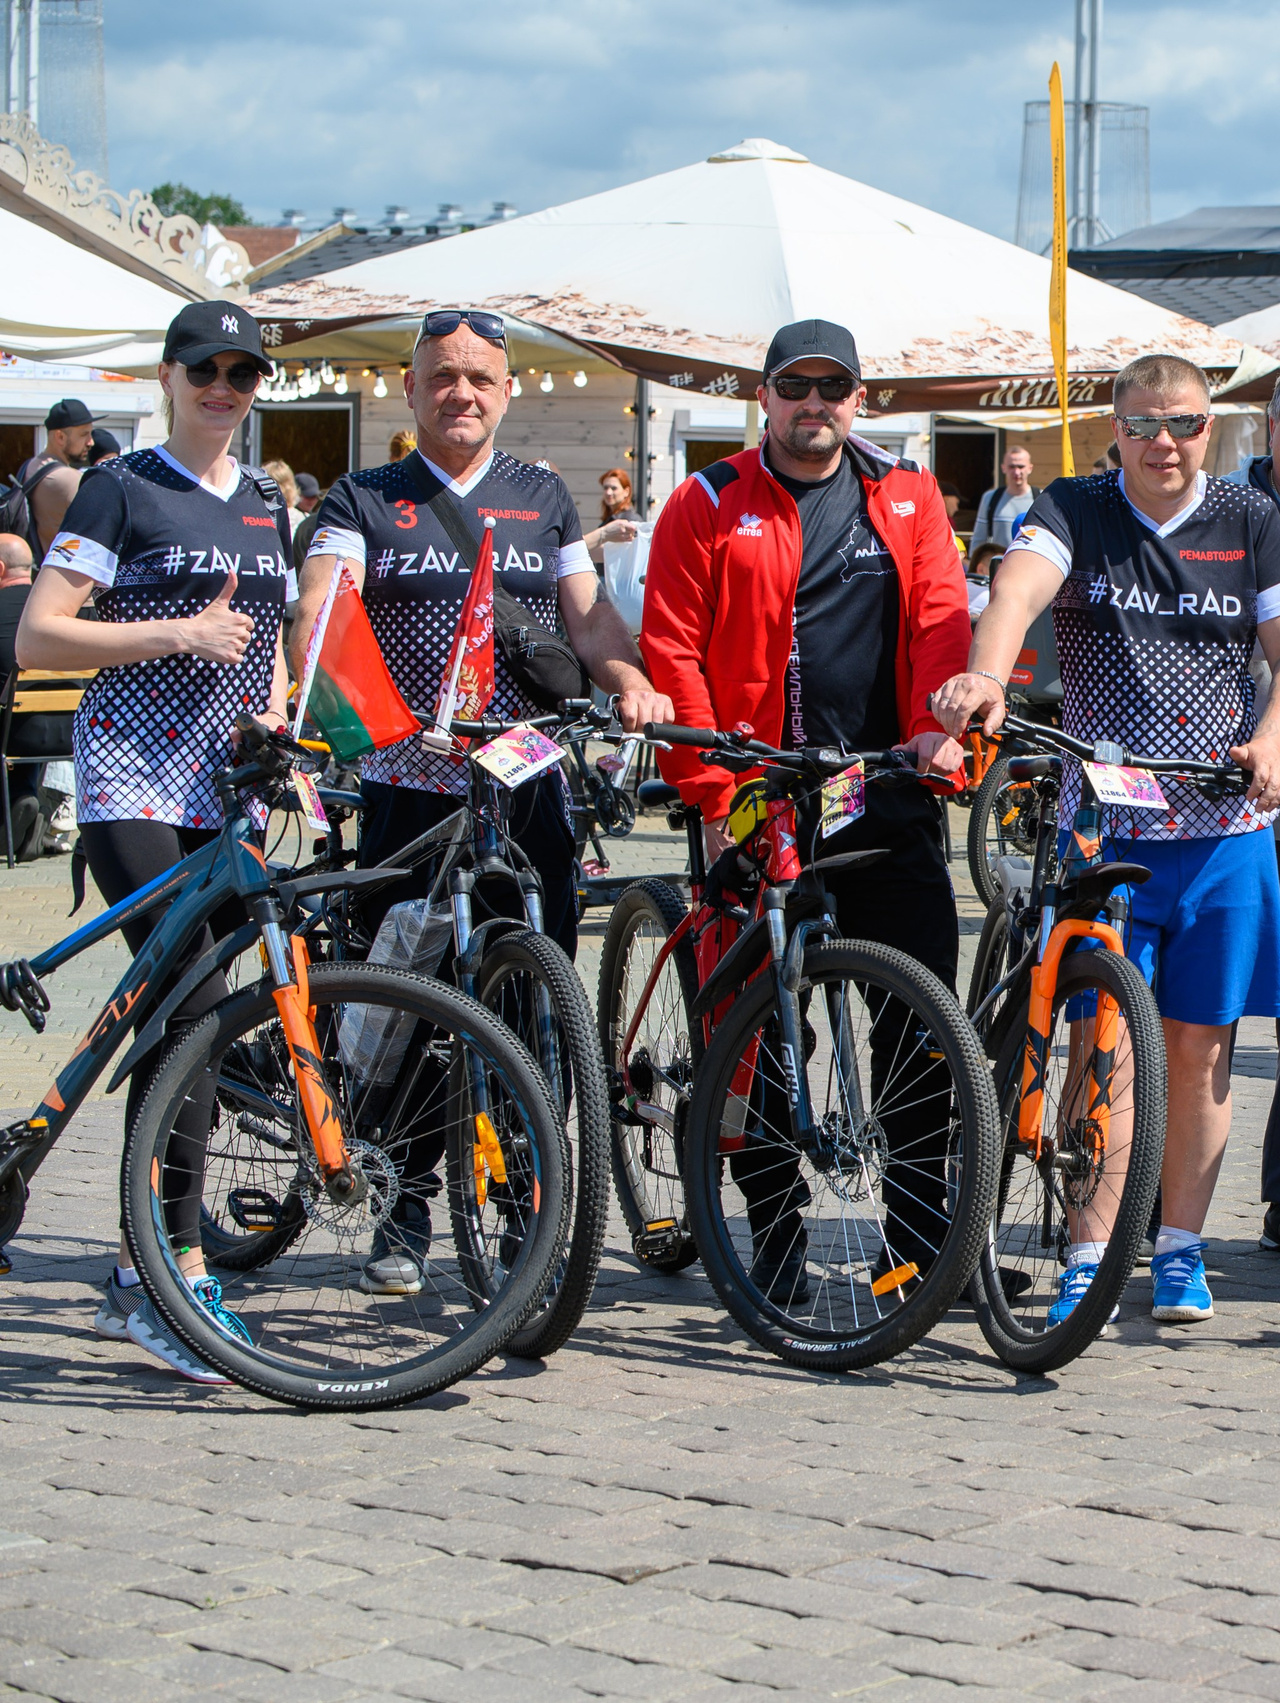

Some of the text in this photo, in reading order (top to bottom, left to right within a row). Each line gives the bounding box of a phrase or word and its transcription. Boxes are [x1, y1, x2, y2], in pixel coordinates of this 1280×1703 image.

[477, 507, 540, 522] РЕМАВТОДОР
[162, 545, 288, 577] #ZAV_RA
[1179, 550, 1246, 563] РЕМАВТОДОР
[1088, 574, 1242, 617] #ZAV_RAD
[502, 762, 528, 779] 11863
[1100, 789, 1127, 798] 11864
[791, 1340, 839, 1352] TERRAINS
[839, 1340, 858, 1350] ALL
[317, 1379, 389, 1394] KENDA
